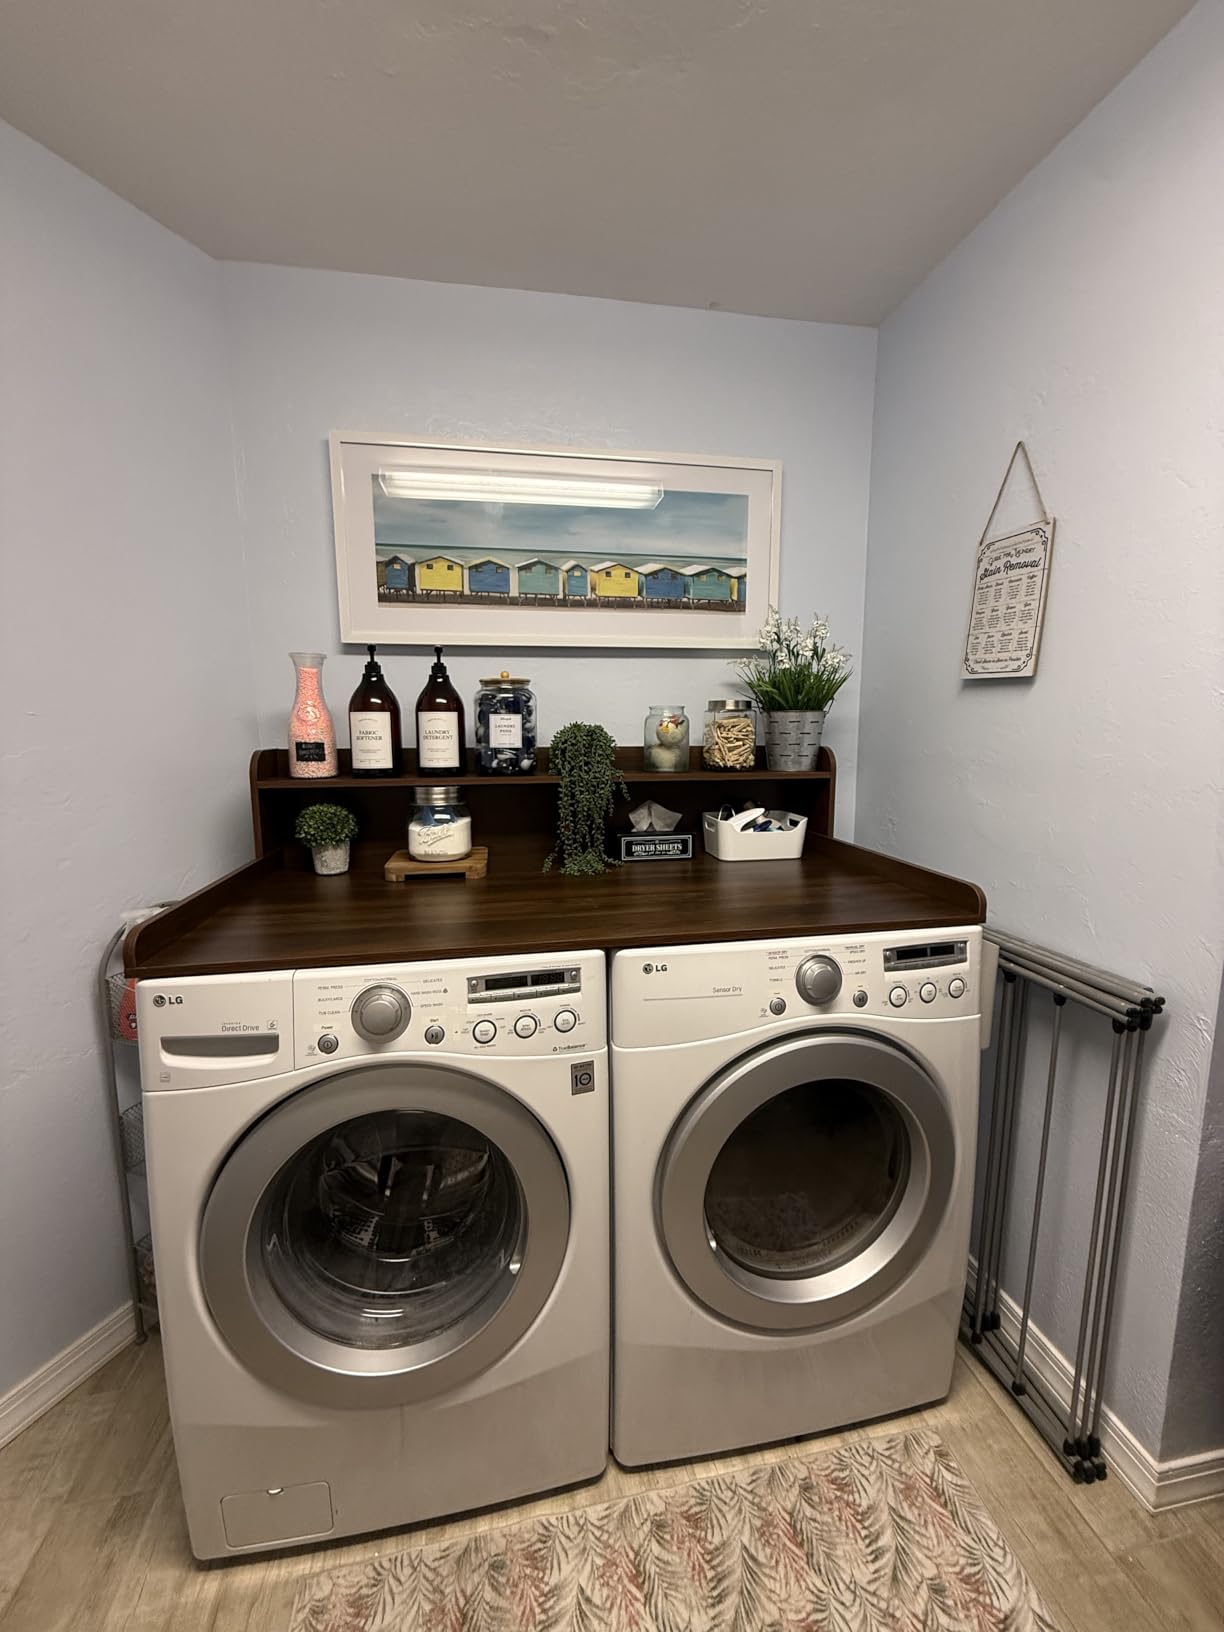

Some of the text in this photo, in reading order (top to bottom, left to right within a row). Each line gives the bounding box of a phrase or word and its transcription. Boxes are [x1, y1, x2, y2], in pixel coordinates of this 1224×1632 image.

[979, 556, 1042, 583] Stain Removal
[631, 843, 682, 852] DRYER SHEETS
[655, 964, 668, 972] LG
[732, 985, 742, 993] Dry
[168, 996, 183, 1005] LG
